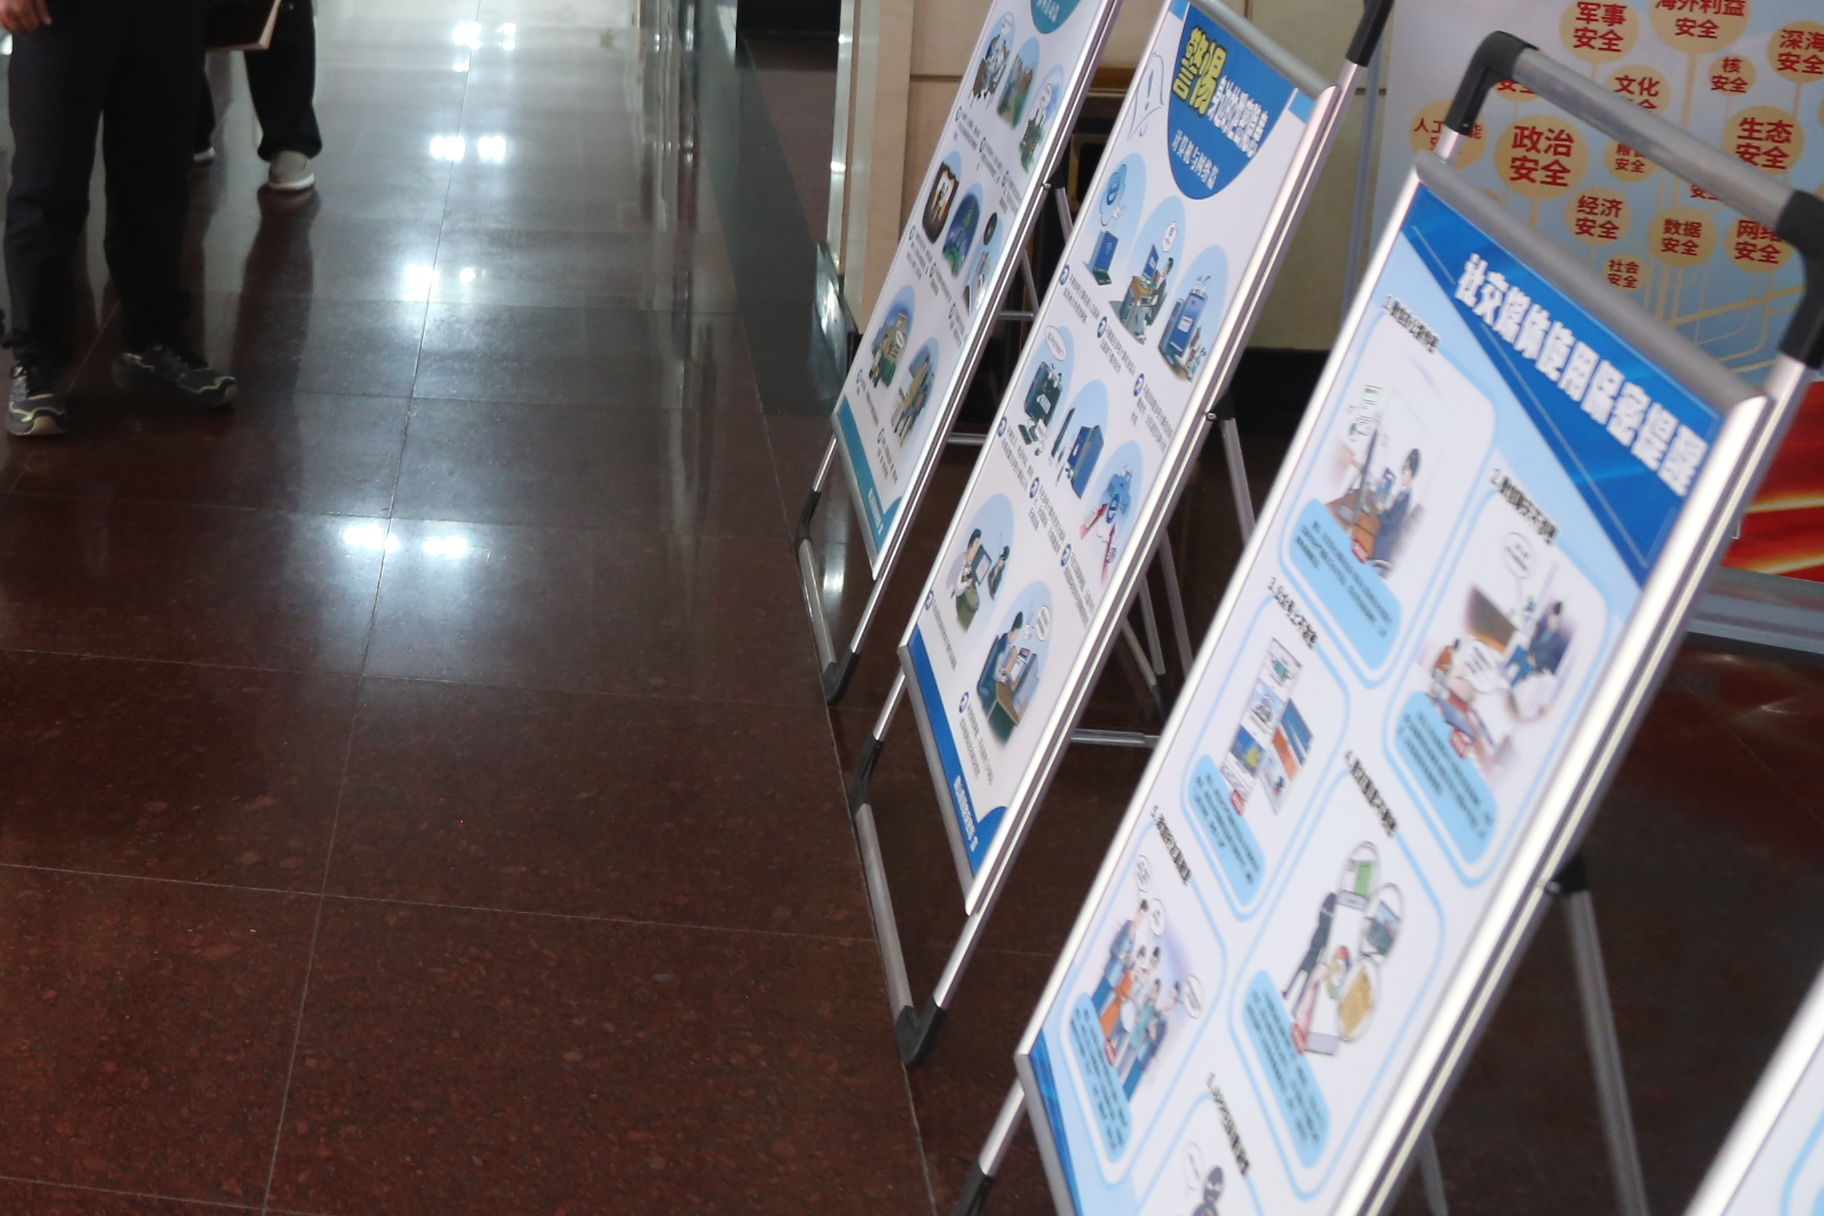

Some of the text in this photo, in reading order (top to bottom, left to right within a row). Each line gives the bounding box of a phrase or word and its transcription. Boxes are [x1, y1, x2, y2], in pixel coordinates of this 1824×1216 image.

[1576, 1, 1626, 27] 军事
[1573, 26, 1624, 52] 安全
[1674, 18, 1719, 39] 安全
[1173, 26, 1227, 117] 警惕
[1722, 57, 1742, 74] 核
[1778, 52, 1824, 75] 安全
[1614, 75, 1660, 97] 文化
[1710, 75, 1748, 93] 安全
[1414, 118, 1482, 139] 人工能
[1738, 118, 1794, 144] 生态
[1511, 125, 1575, 157] 政治
[1615, 158, 1645, 174] 安全
[1735, 144, 1789, 170] 安全
[1509, 156, 1571, 187] 安全
[1577, 196, 1623, 219] 经济
[1575, 218, 1619, 240] 安全
[1663, 219, 1703, 239] 数据
[1661, 238, 1699, 256] 安全
[1734, 241, 1782, 264] 安全
[1608, 259, 1640, 274] 社会
[1608, 274, 1638, 289] 安全
[1453, 252, 1709, 497] 社交媒体使用保密提醒
